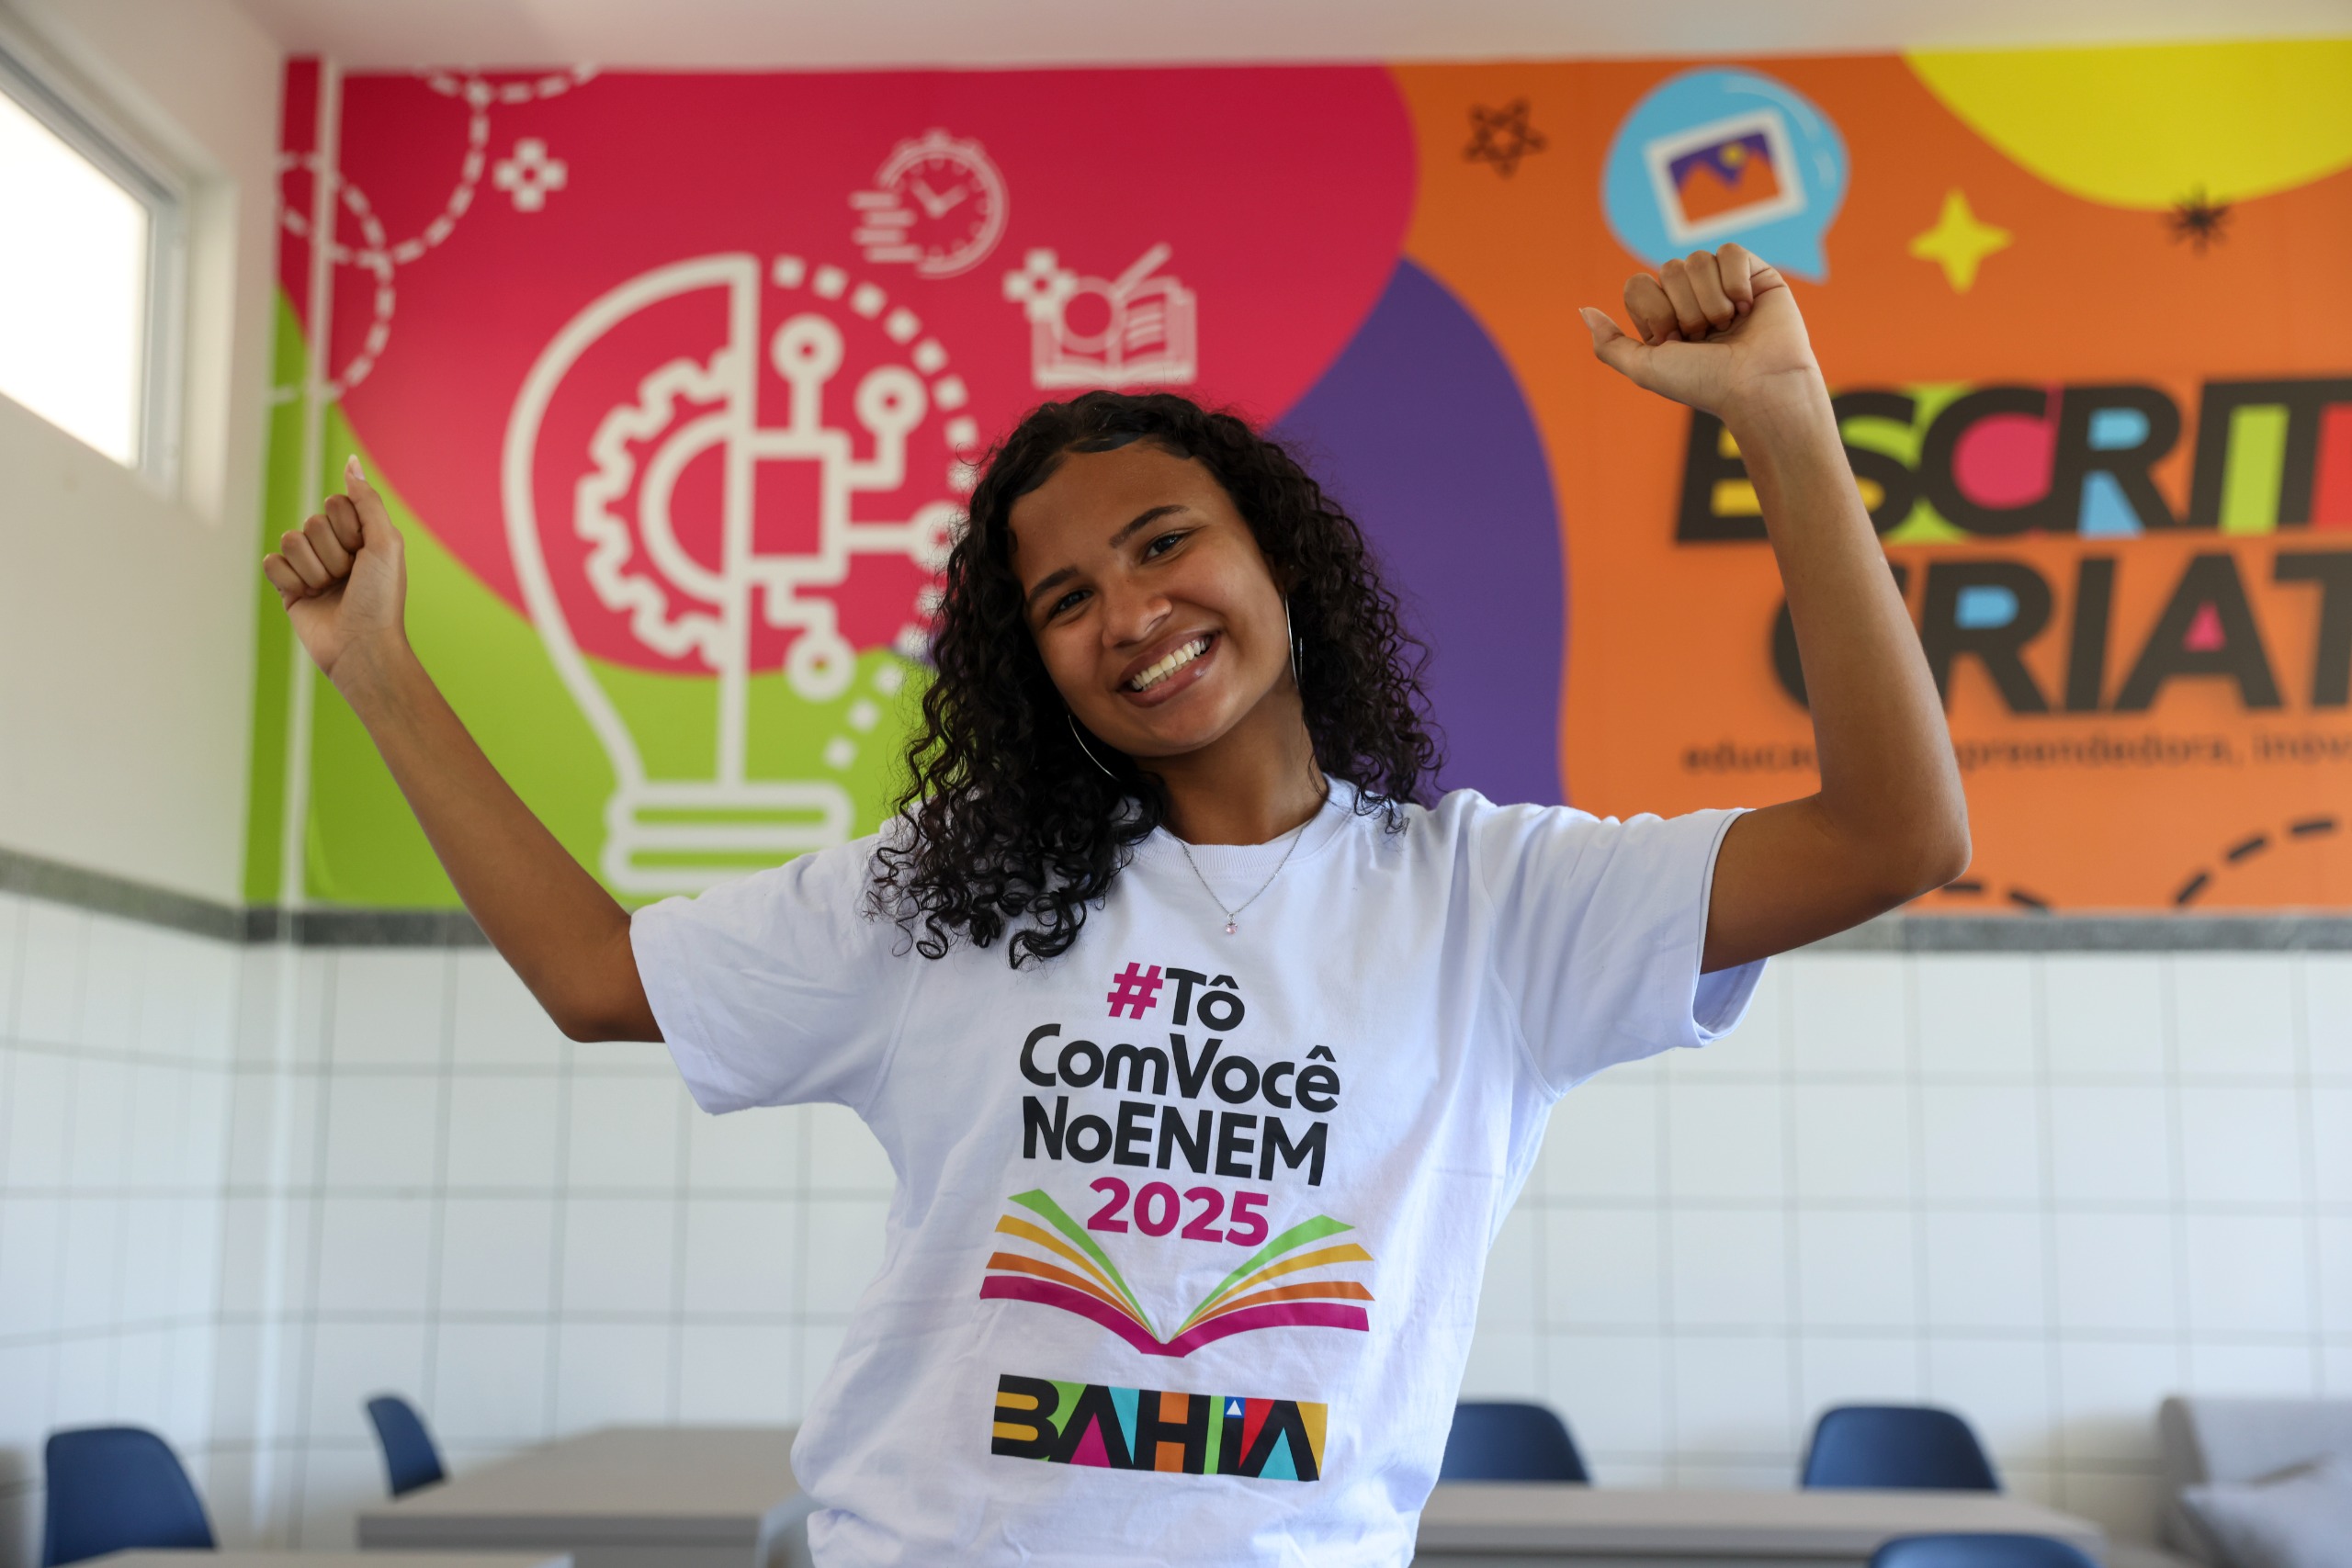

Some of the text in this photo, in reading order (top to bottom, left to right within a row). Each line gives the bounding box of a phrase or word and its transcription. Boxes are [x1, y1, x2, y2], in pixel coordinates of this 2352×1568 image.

[1682, 738, 1816, 773] educa
[1954, 732, 2242, 772] preendedora,
[1106, 962, 1246, 1032] #Tô
[1019, 1023, 1340, 1113] ComVocê
[1022, 1095, 1329, 1187] NoENEM
[1087, 1176, 1269, 1247] 2025
[991, 1373, 1328, 1483] BAHIA
